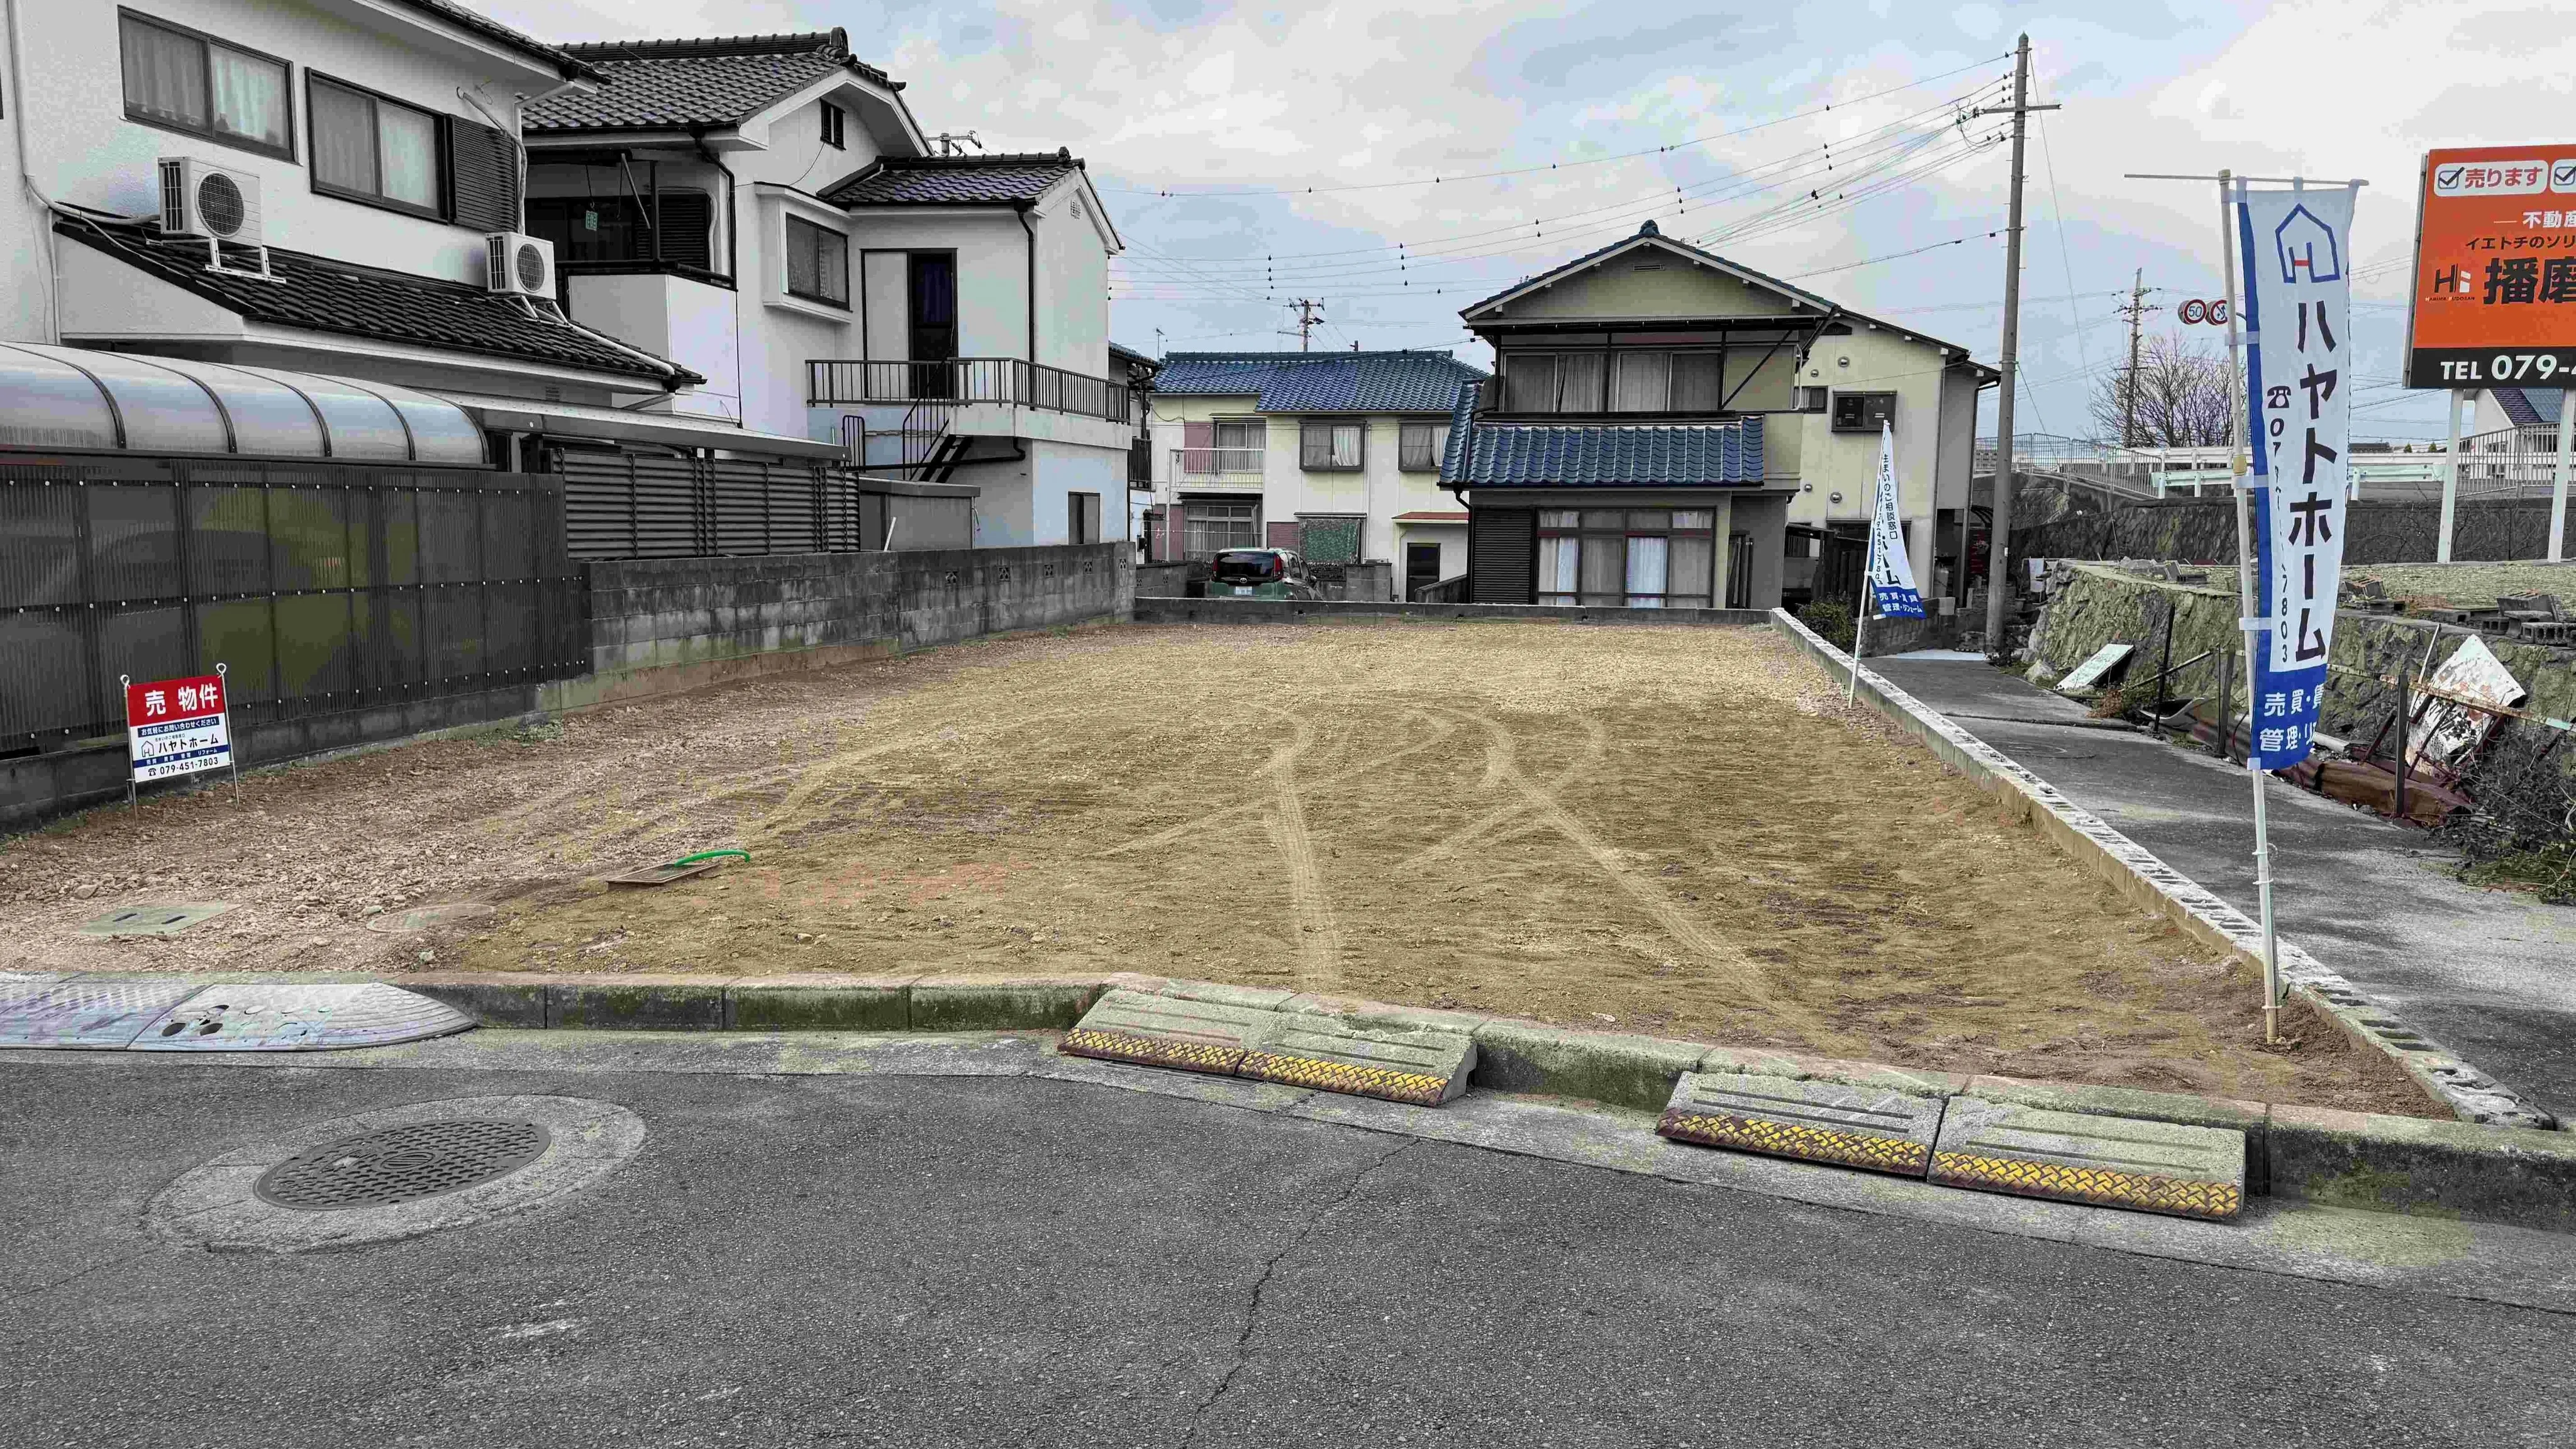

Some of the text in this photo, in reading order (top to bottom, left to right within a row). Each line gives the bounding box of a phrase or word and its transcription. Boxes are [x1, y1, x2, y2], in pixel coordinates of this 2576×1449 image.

[2465, 167, 2543, 189] 売ります
[2189, 306, 2202, 318] 50
[2441, 354, 2576, 380] TEL 079-
[2289, 301, 2338, 663] ハヤトホーム
[158, 733, 219, 753] ハヤトホーム
[160, 757, 219, 775] 079-451-7803
